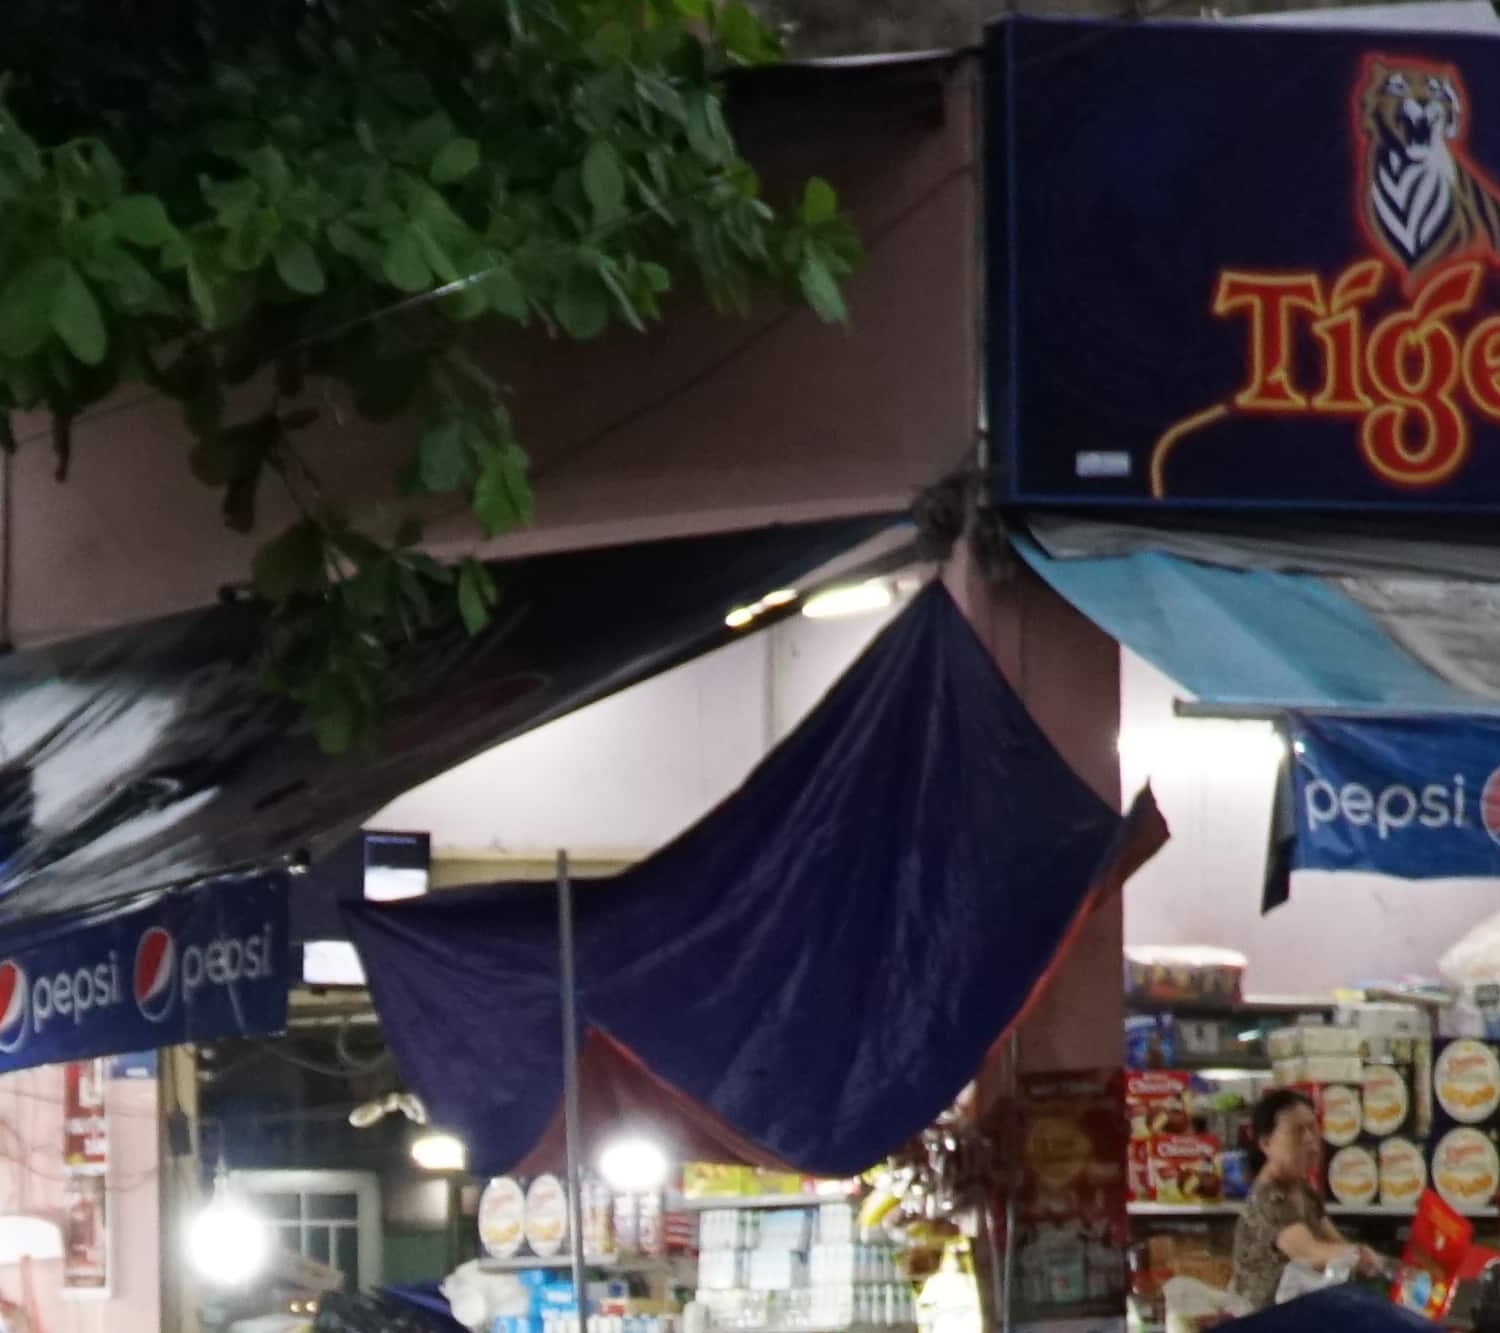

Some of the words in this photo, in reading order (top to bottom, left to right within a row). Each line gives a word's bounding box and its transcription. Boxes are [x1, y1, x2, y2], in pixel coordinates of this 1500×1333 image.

[1304, 774, 1468, 840] pepsi
[33, 949, 123, 1034] pepsi
[184, 923, 275, 1004] pepsi
